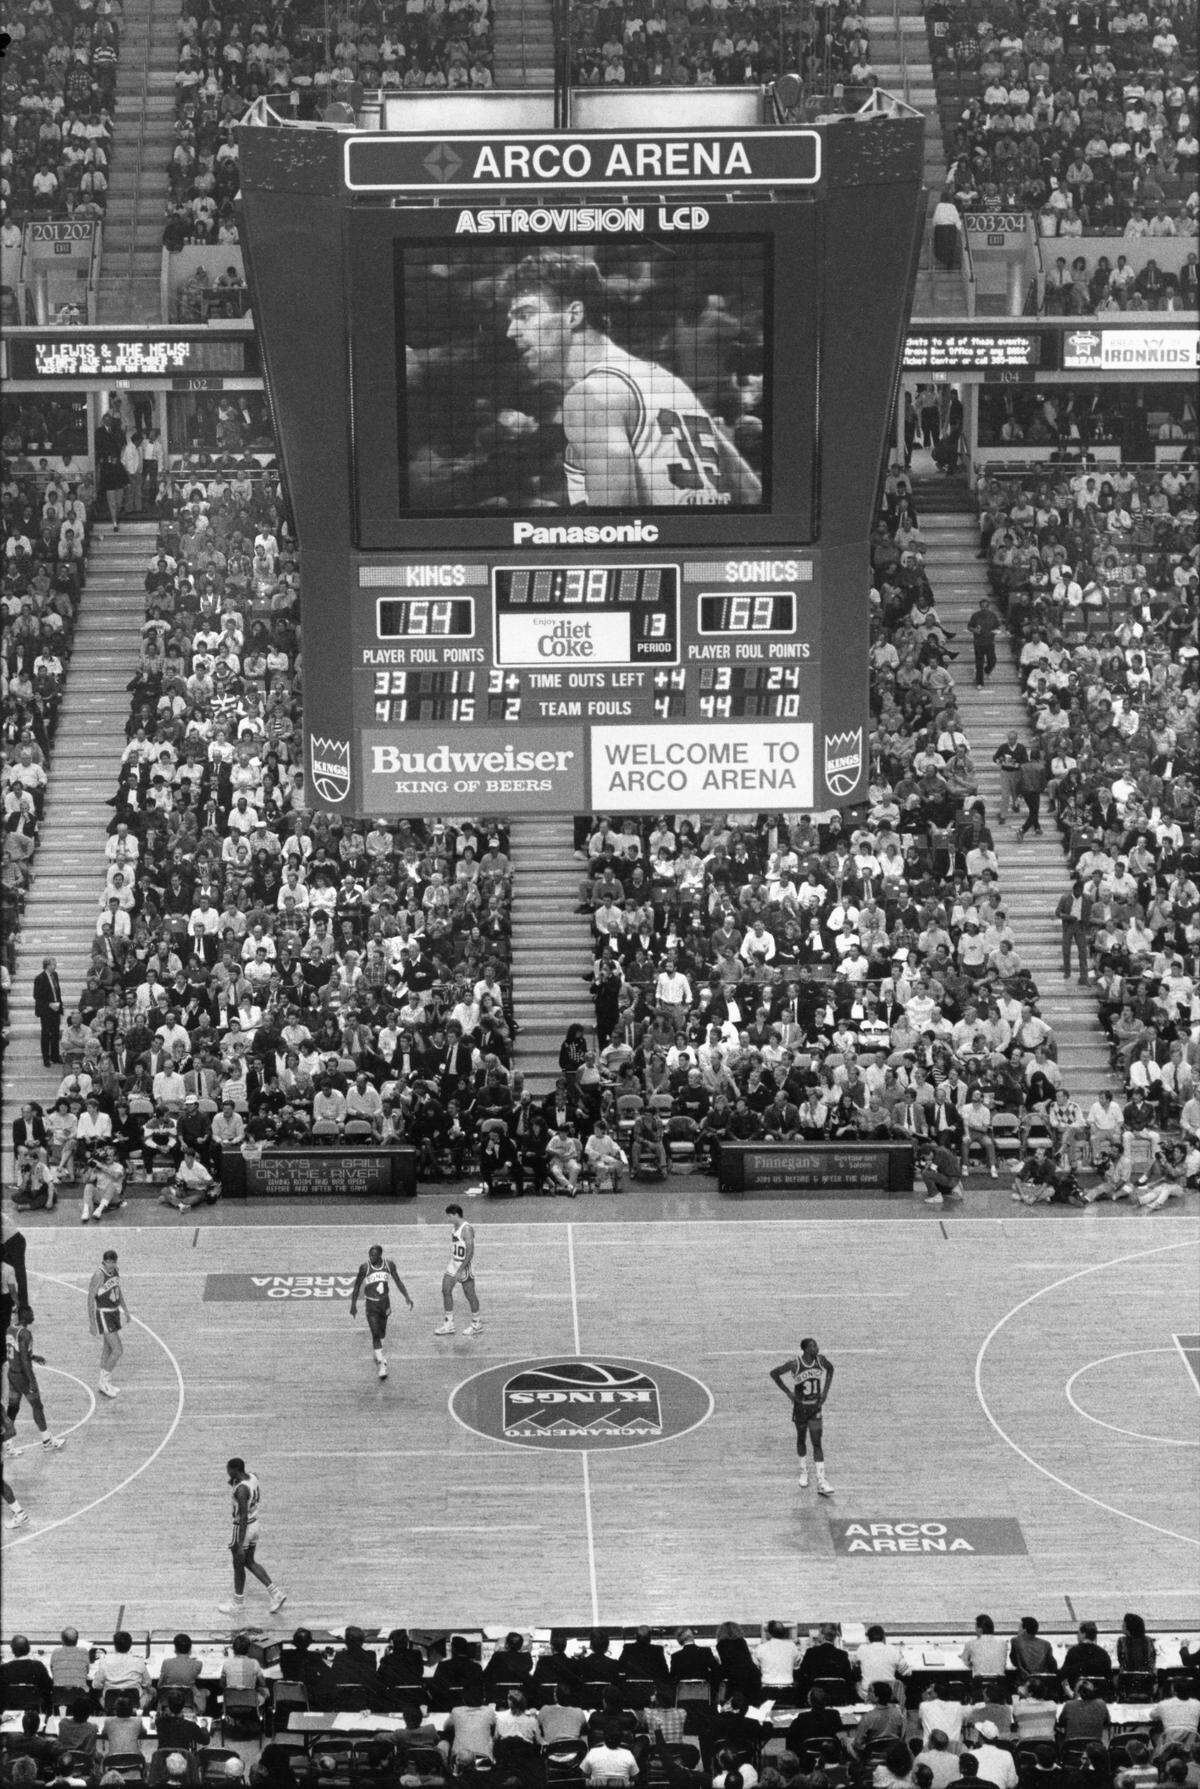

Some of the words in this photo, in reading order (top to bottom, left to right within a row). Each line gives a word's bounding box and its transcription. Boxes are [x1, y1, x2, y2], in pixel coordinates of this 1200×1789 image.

[473, 144, 592, 178] ARCO
[604, 142, 752, 176] ARENA
[455, 207, 645, 233] ASTROVISION
[658, 206, 710, 230] LCD
[967, 216, 995, 232] 203
[997, 216, 1025, 232] 204
[34, 224, 60, 240] 201
[63, 224, 91, 239] 202
[52, 344, 95, 357] LEWIS
[101, 344, 111, 357] &
[118, 343, 143, 356] THE
[149, 342, 190, 356] NEWS!
[1104, 349, 1190, 362] IRONKIDS
[188, 380, 208, 390] 102
[1001, 372, 1019, 383] 104
[513, 519, 659, 544] Panasonic
[406, 564, 466, 587] KINGS
[725, 560, 798, 583] SONICS
[407, 601, 452, 634] 54
[729, 597, 774, 630] 69
[553, 620, 591, 639] diet
[538, 635, 593, 657] Coke
[637, 643, 671, 653] PERIOD
[688, 645, 730, 659] PLAYER
[735, 644, 764, 658] FOUL
[769, 643, 810, 658] POINTS
[363, 649, 405, 664] PLAYER
[410, 648, 438, 663] FOUL
[443, 648, 485, 662] POINTS
[374, 671, 407, 695] 33
[451, 670, 475, 694] 11
[529, 673, 562, 689] TIME
[569, 673, 605, 688] OUTS
[612, 672, 645, 687] LEFT
[715, 667, 732, 690] 3
[767, 666, 800, 690] 24
[375, 699, 407, 722] 41
[451, 698, 475, 721] 15
[505, 698, 521, 721] 2
[539, 701, 581, 716] TEAM
[587, 700, 632, 715] FOULS
[654, 696, 670, 718] 4
[699, 695, 732, 718] 44
[775, 694, 800, 717] 10
[371, 744, 574, 773] Budweiser
[605, 742, 749, 765] WELCOME
[762, 741, 800, 763] TO
[828, 753, 859, 770] KINGS
[314, 760, 348, 776] KINGS
[395, 781, 449, 793] KING
[454, 780, 481, 792] OF
[485, 779, 553, 792] BEERS
[608, 769, 688, 792] ARCO
[702, 768, 796, 791] ARENA
[249, 1158, 310, 1169] RICKY'S
[341, 1158, 385, 1168] GRILL
[753, 1155, 820, 1171] Finnegan's
[256, 1169, 279, 1179] ON
[288, 1169, 320, 1178] THE
[330, 1168, 379, 1178] RIVER
[251, 1276, 358, 1287] ARENA
[267, 1287, 355, 1298] ARCO
[509, 1391, 651, 1404] KINGS
[505, 1427, 663, 1437] SACRAMENTO
[845, 1523, 947, 1536] ARCO
[847, 1538, 976, 1551] ARENA
